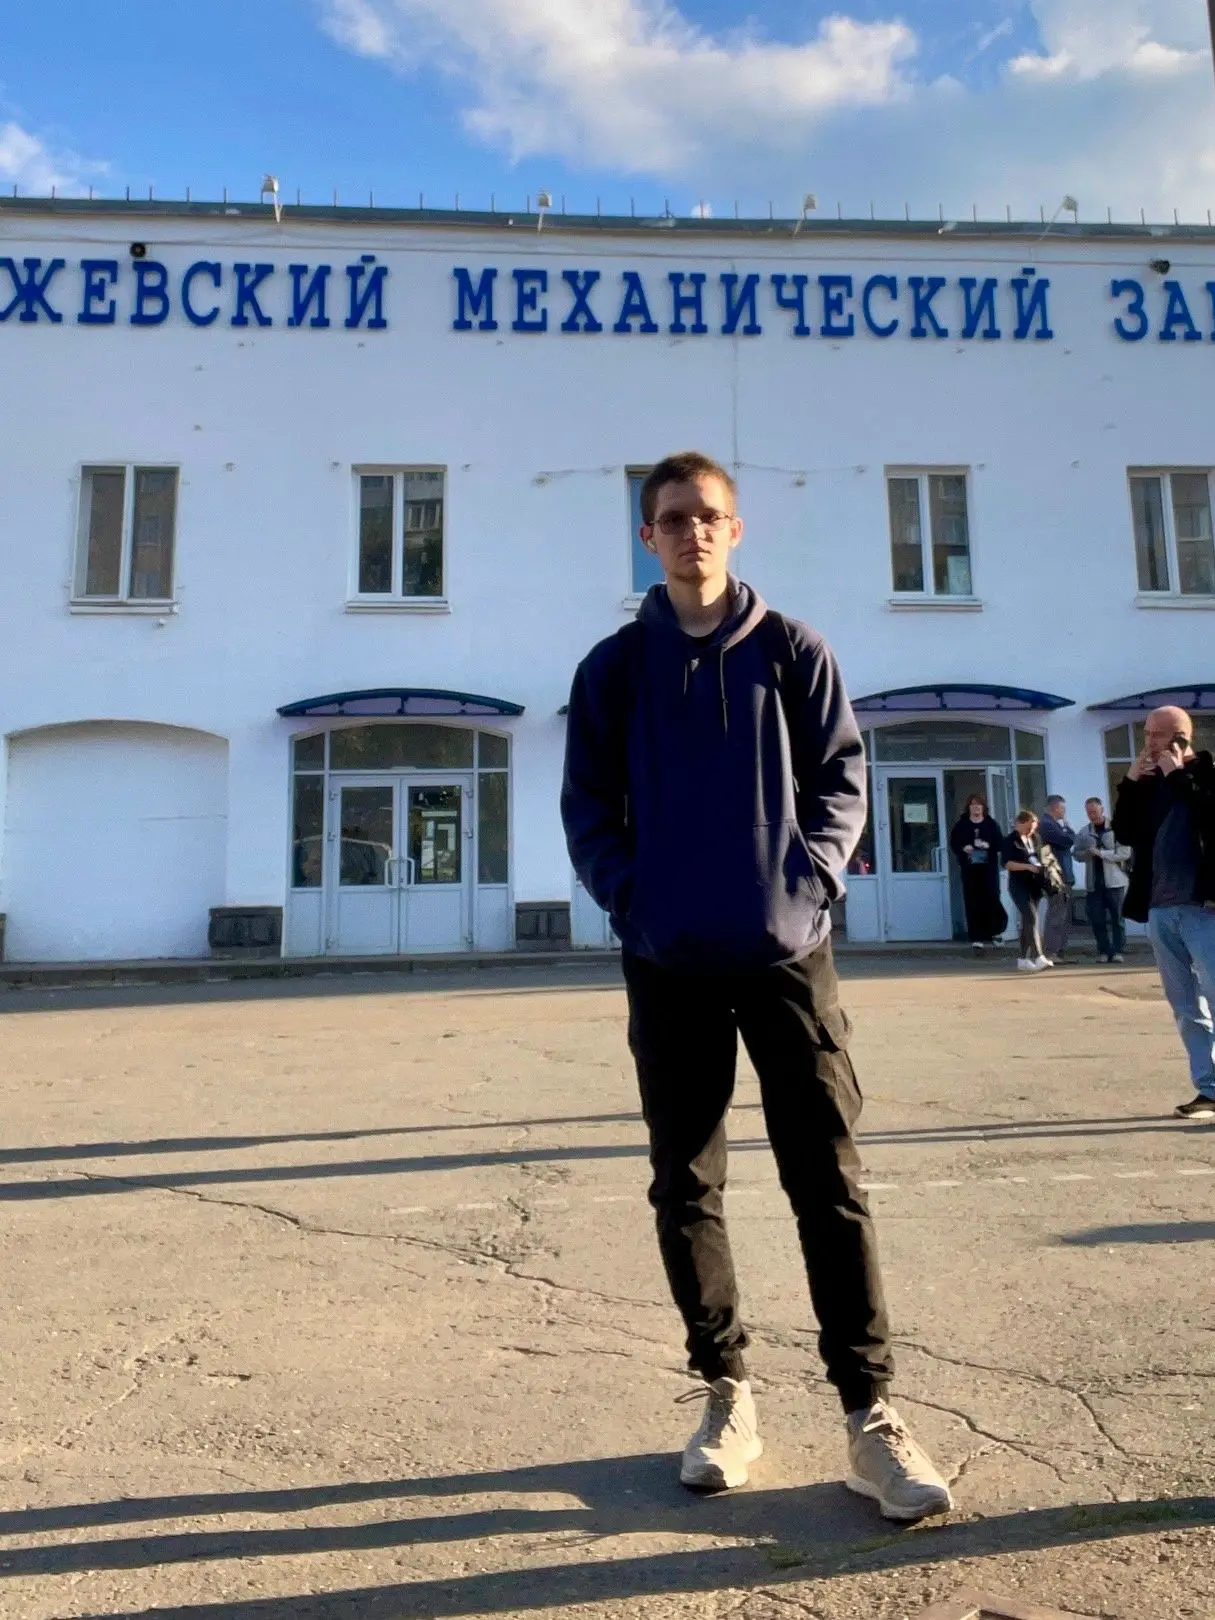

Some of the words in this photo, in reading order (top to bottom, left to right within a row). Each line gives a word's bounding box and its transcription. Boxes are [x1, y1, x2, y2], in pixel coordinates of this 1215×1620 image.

[0, 254, 389, 329] ЖЕВСКИЙ
[452, 267, 1054, 341] МЕХАНИЧЕСКИЙ
[1110, 278, 1215, 343] ЗА
